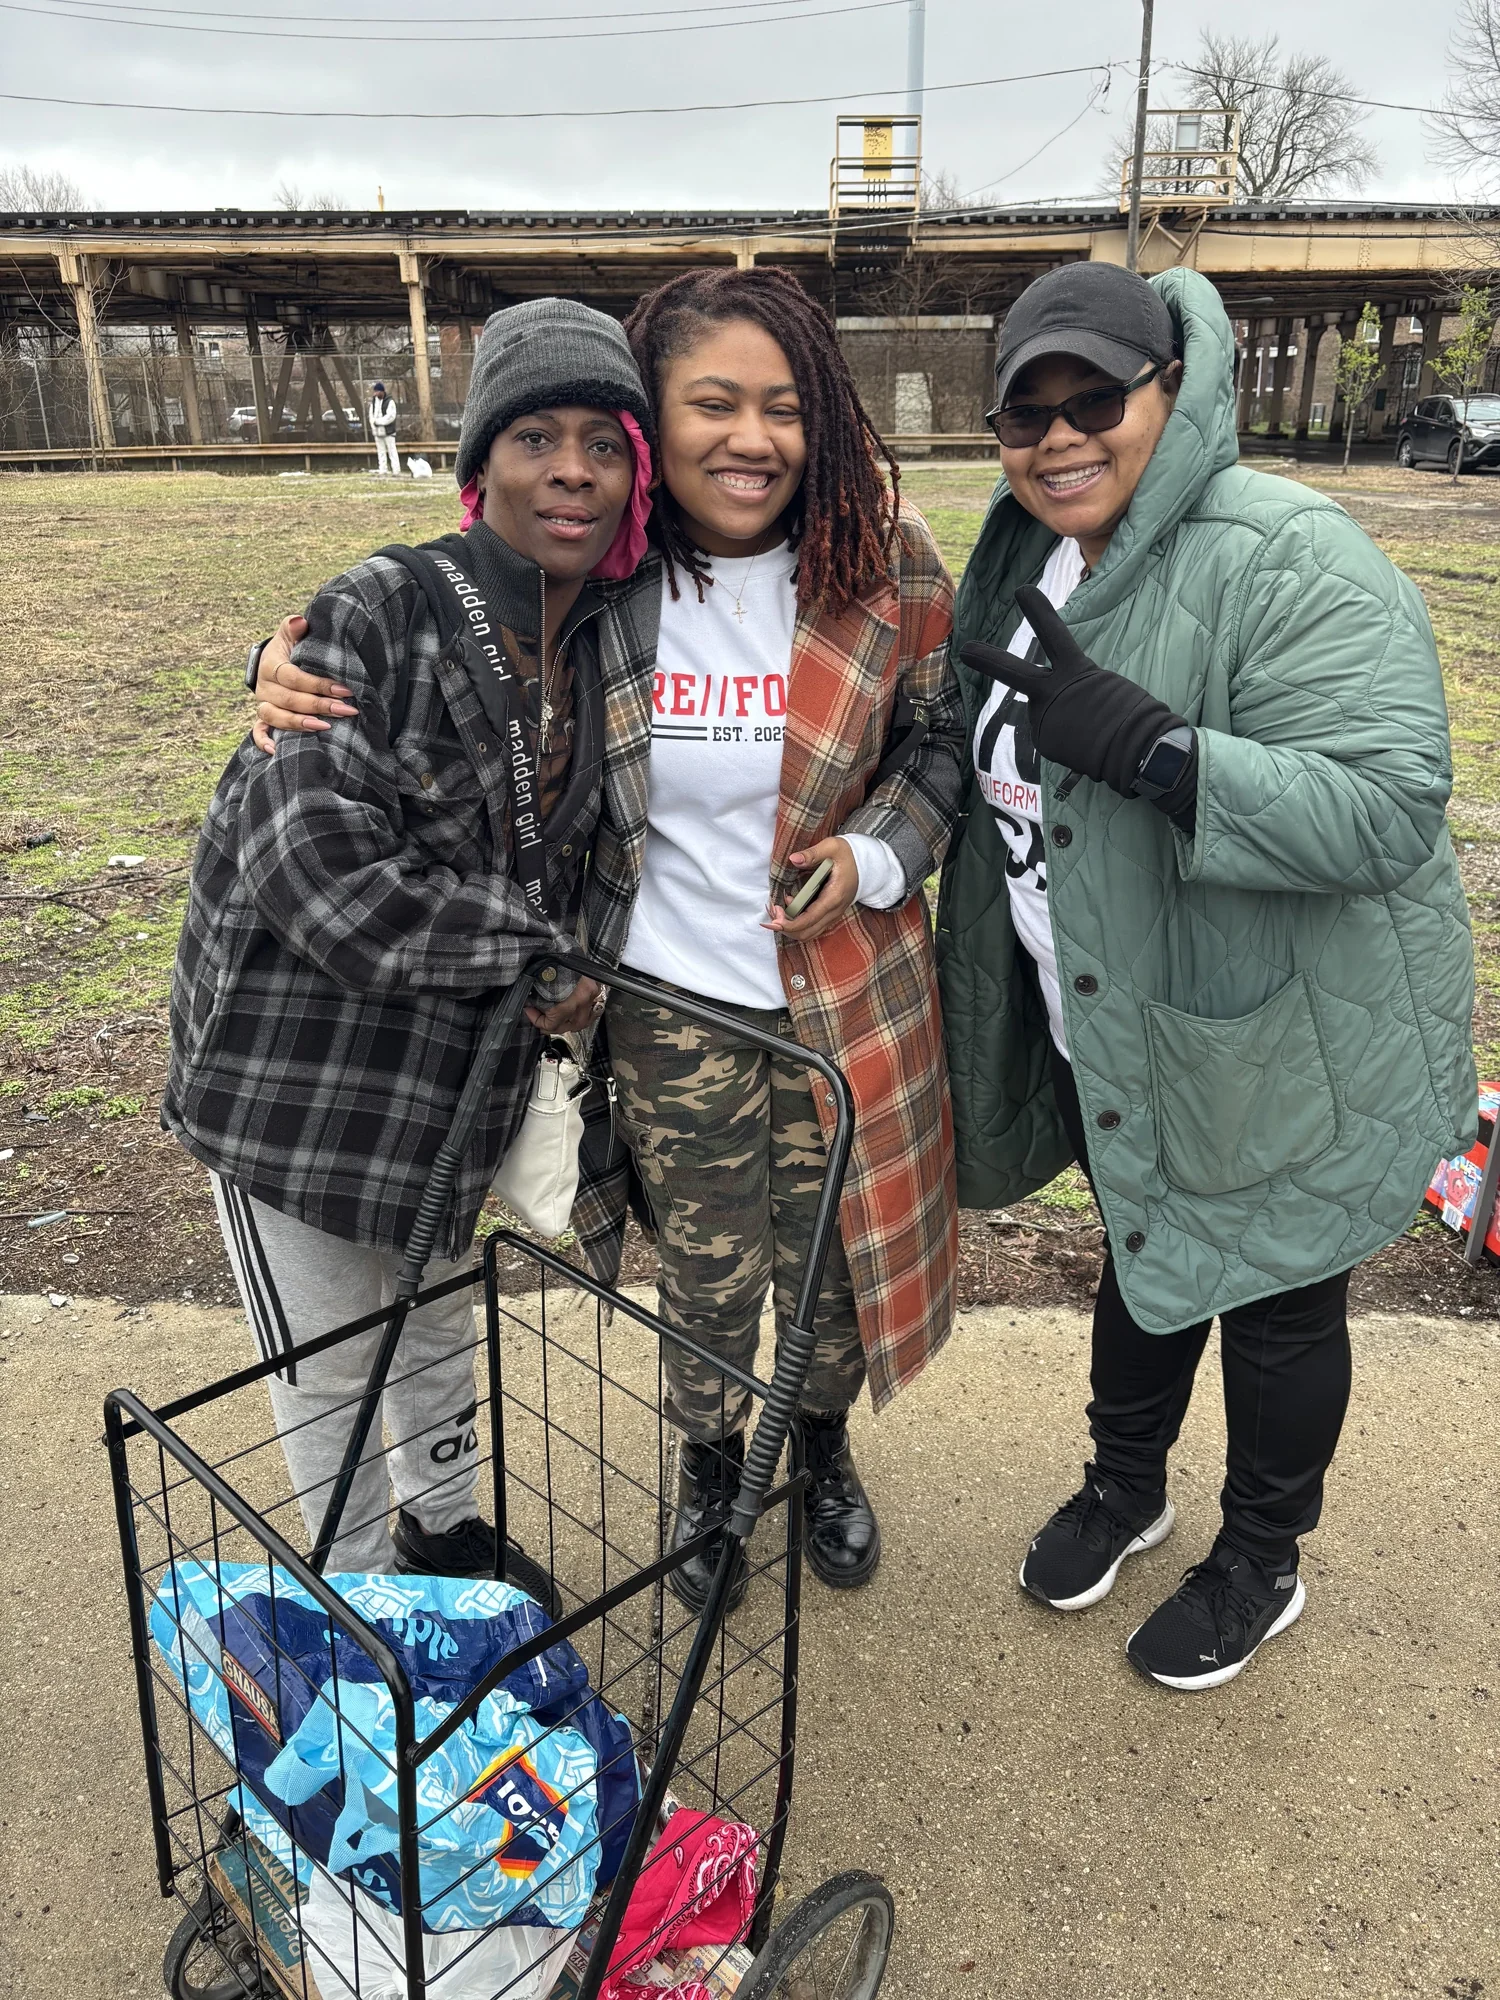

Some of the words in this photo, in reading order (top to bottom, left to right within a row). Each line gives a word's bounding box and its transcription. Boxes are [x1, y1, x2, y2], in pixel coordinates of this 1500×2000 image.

[434, 559, 491, 637] madden
[652, 672, 790, 718] RE//FO
[712, 726, 748, 742] EST.
[508, 719, 534, 807] madden
[515, 812, 542, 849] girl
